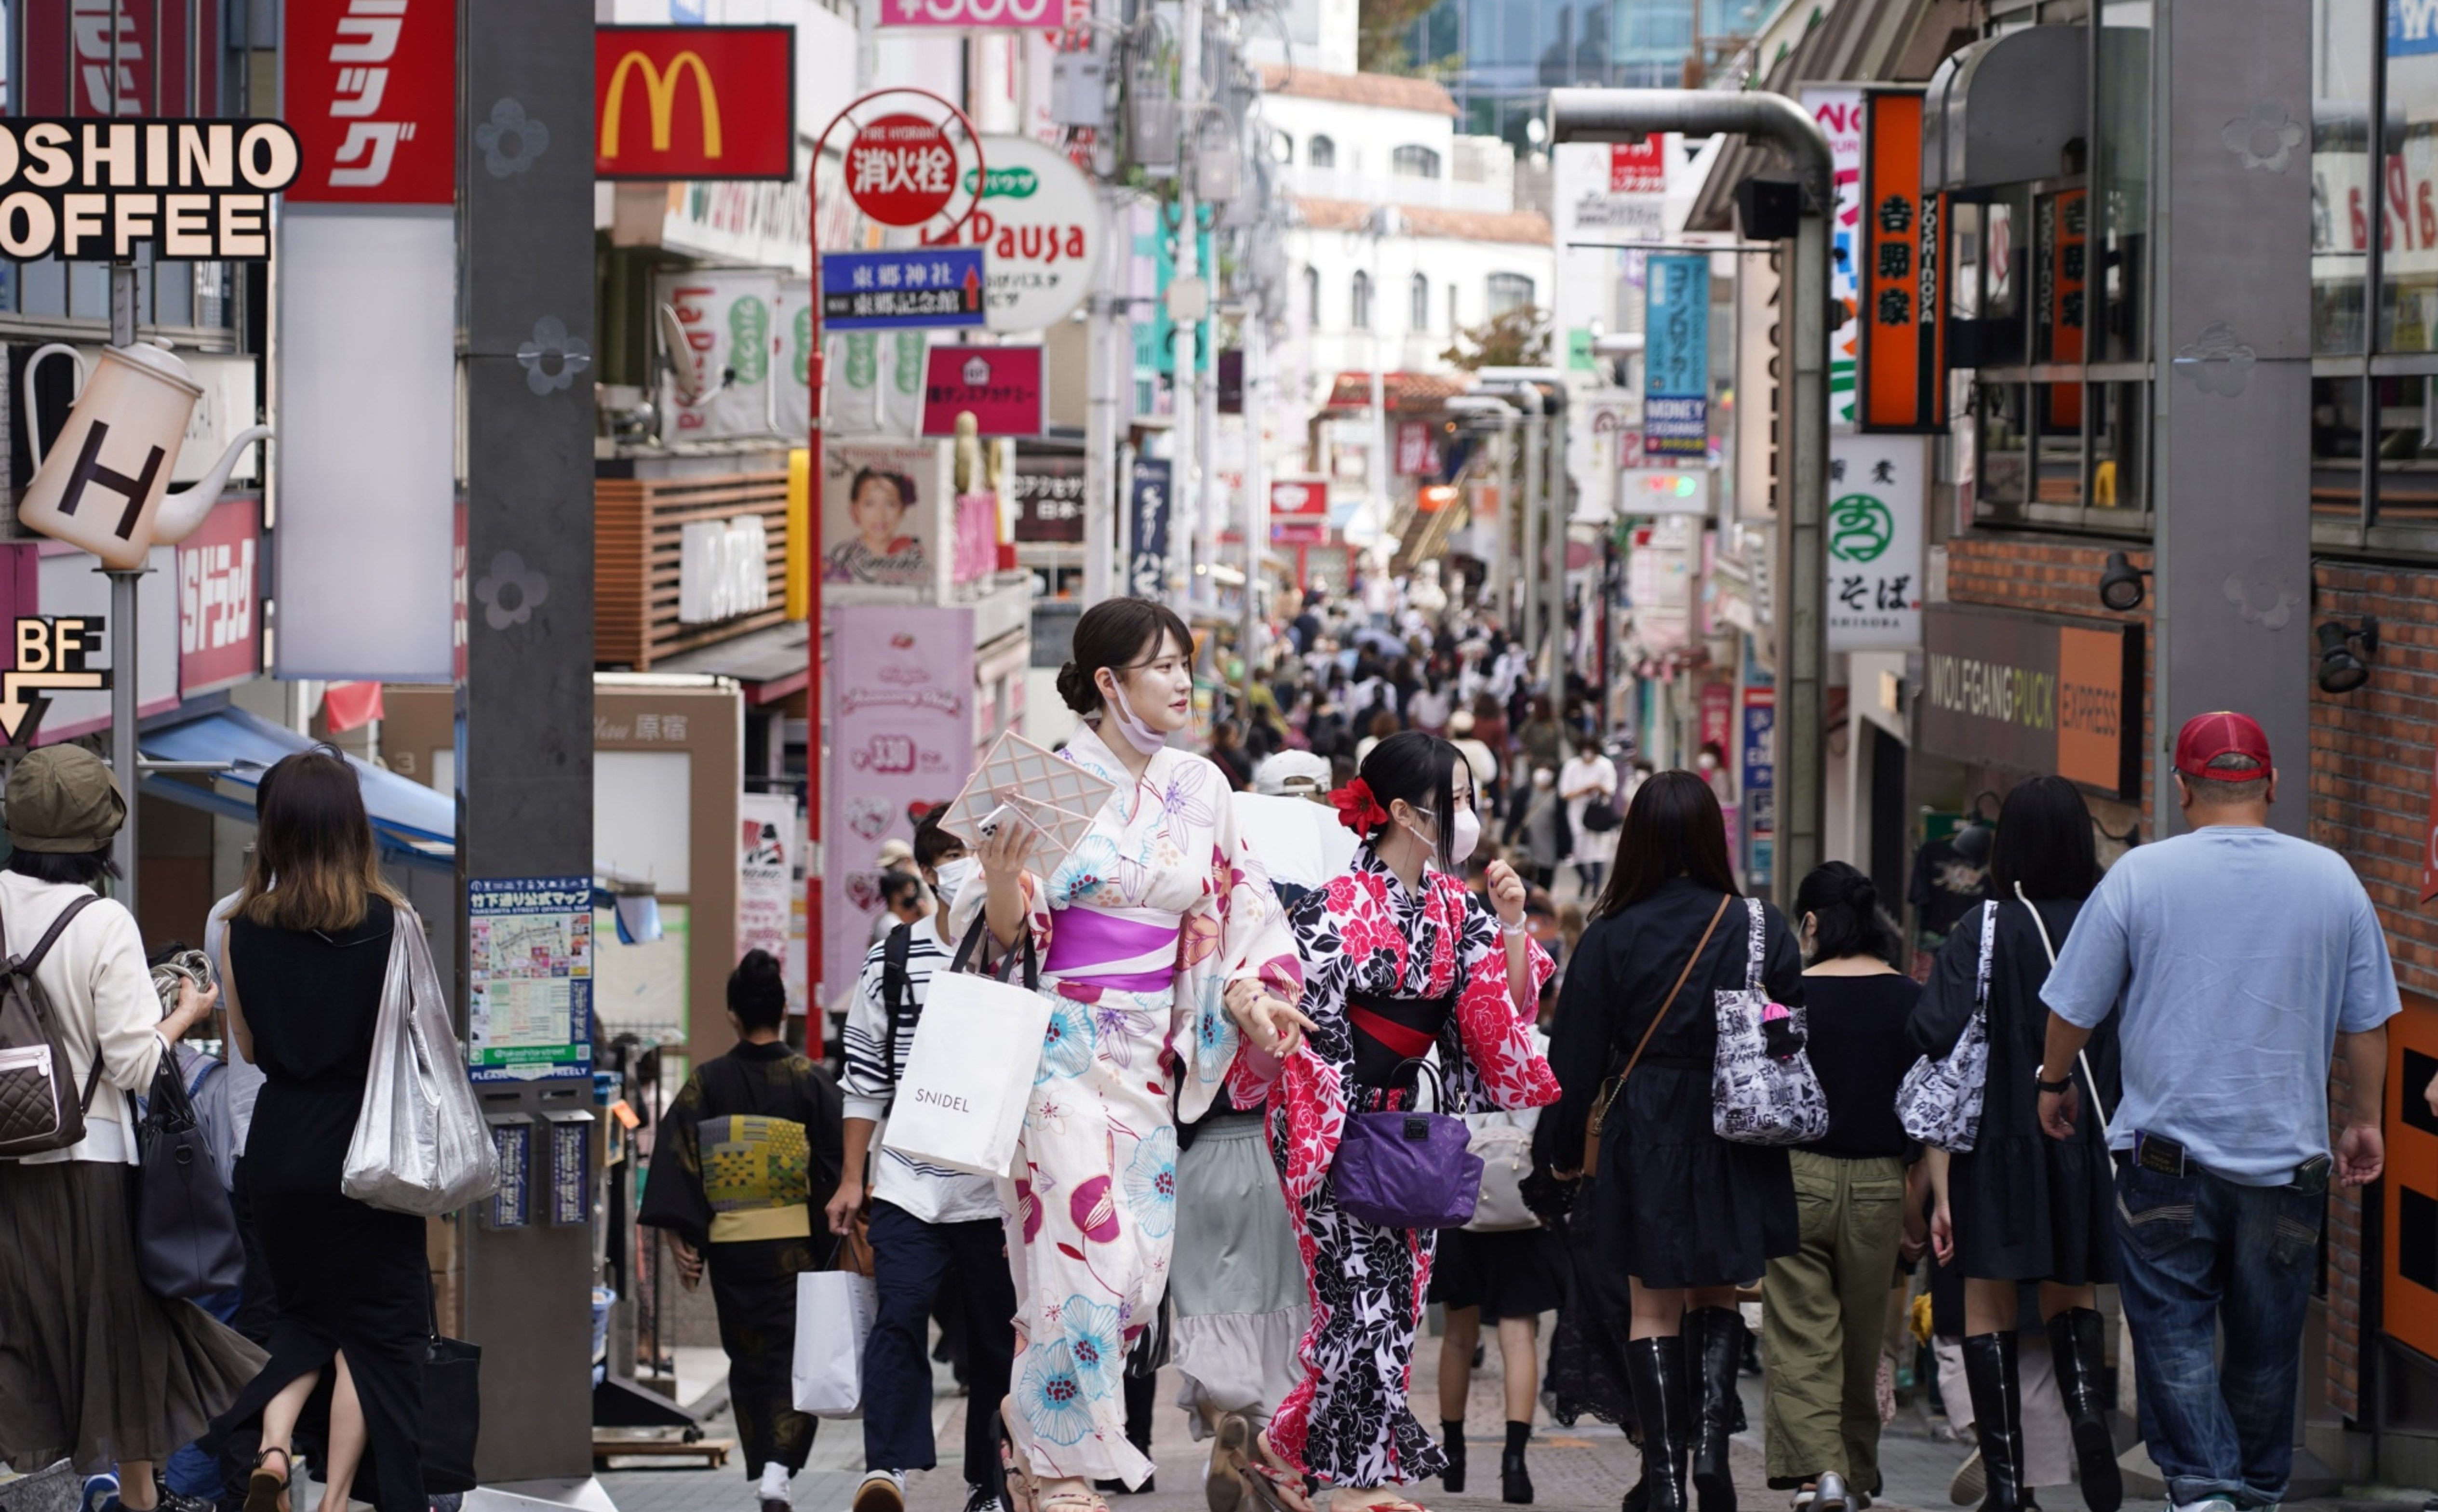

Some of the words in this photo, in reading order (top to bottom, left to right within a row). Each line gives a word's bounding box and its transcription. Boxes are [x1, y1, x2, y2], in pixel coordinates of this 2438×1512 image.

[861, 126, 885, 140] FIRE
[889, 125, 939, 140] HYDRANT
[853, 146, 951, 193] 消火栓
[972, 211, 1083, 264] Pausa
[1878, 195, 1913, 326] 吉野家
[1921, 199, 1936, 323] YOSHINOYA
[853, 263, 958, 288] 東郷神社
[853, 289, 960, 315] 東郷記念館
[57, 419, 166, 541] H
[177, 538, 255, 655] Sドラッグ
[17, 620, 85, 671] BF
[1930, 653, 2013, 723] WOLFGANG
[2014, 668, 2055, 732] PUCK
[2063, 682, 2118, 737] EXPRESS
[636, 714, 688, 741] 原宿
[470, 890, 590, 908] 竹下通り公式マップ
[915, 1088, 969, 1112] SNIDEL
